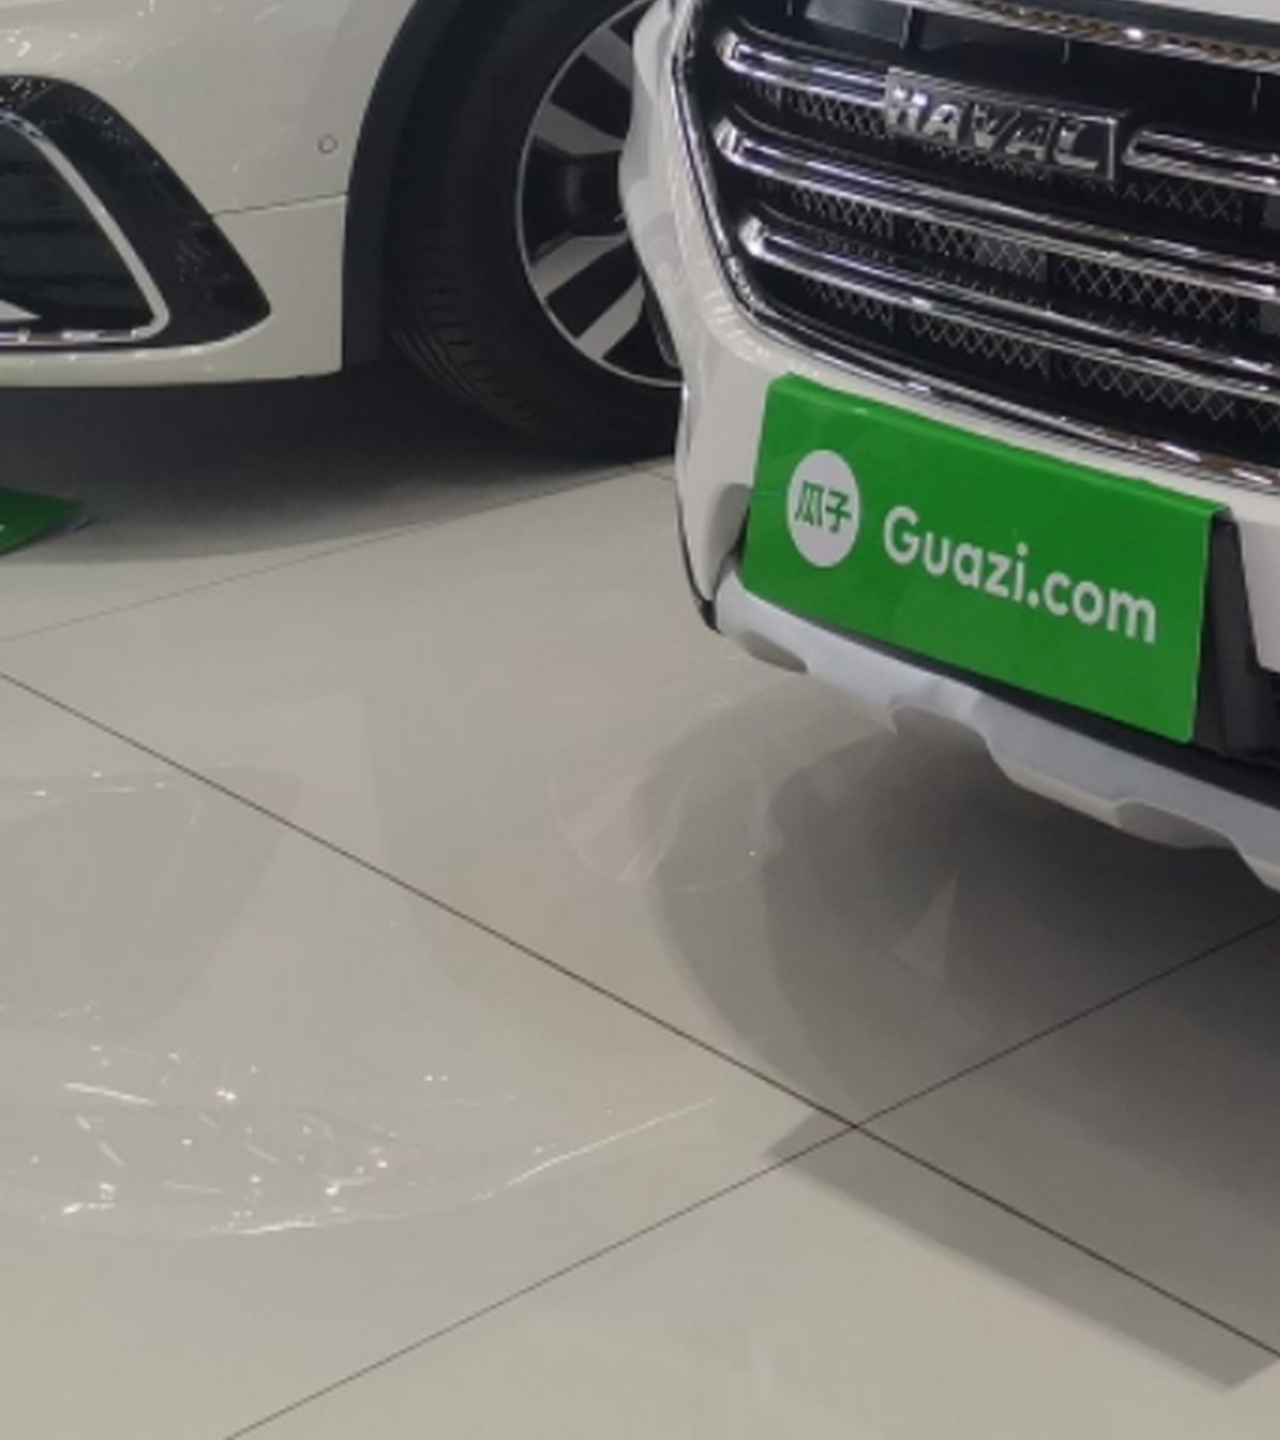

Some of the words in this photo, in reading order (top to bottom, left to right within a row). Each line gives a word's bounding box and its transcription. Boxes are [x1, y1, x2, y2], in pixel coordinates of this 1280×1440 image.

[885, 82, 1098, 170] HAVAL
[794, 479, 853, 534] 瓜子
[883, 505, 1157, 644] Guazi.com
